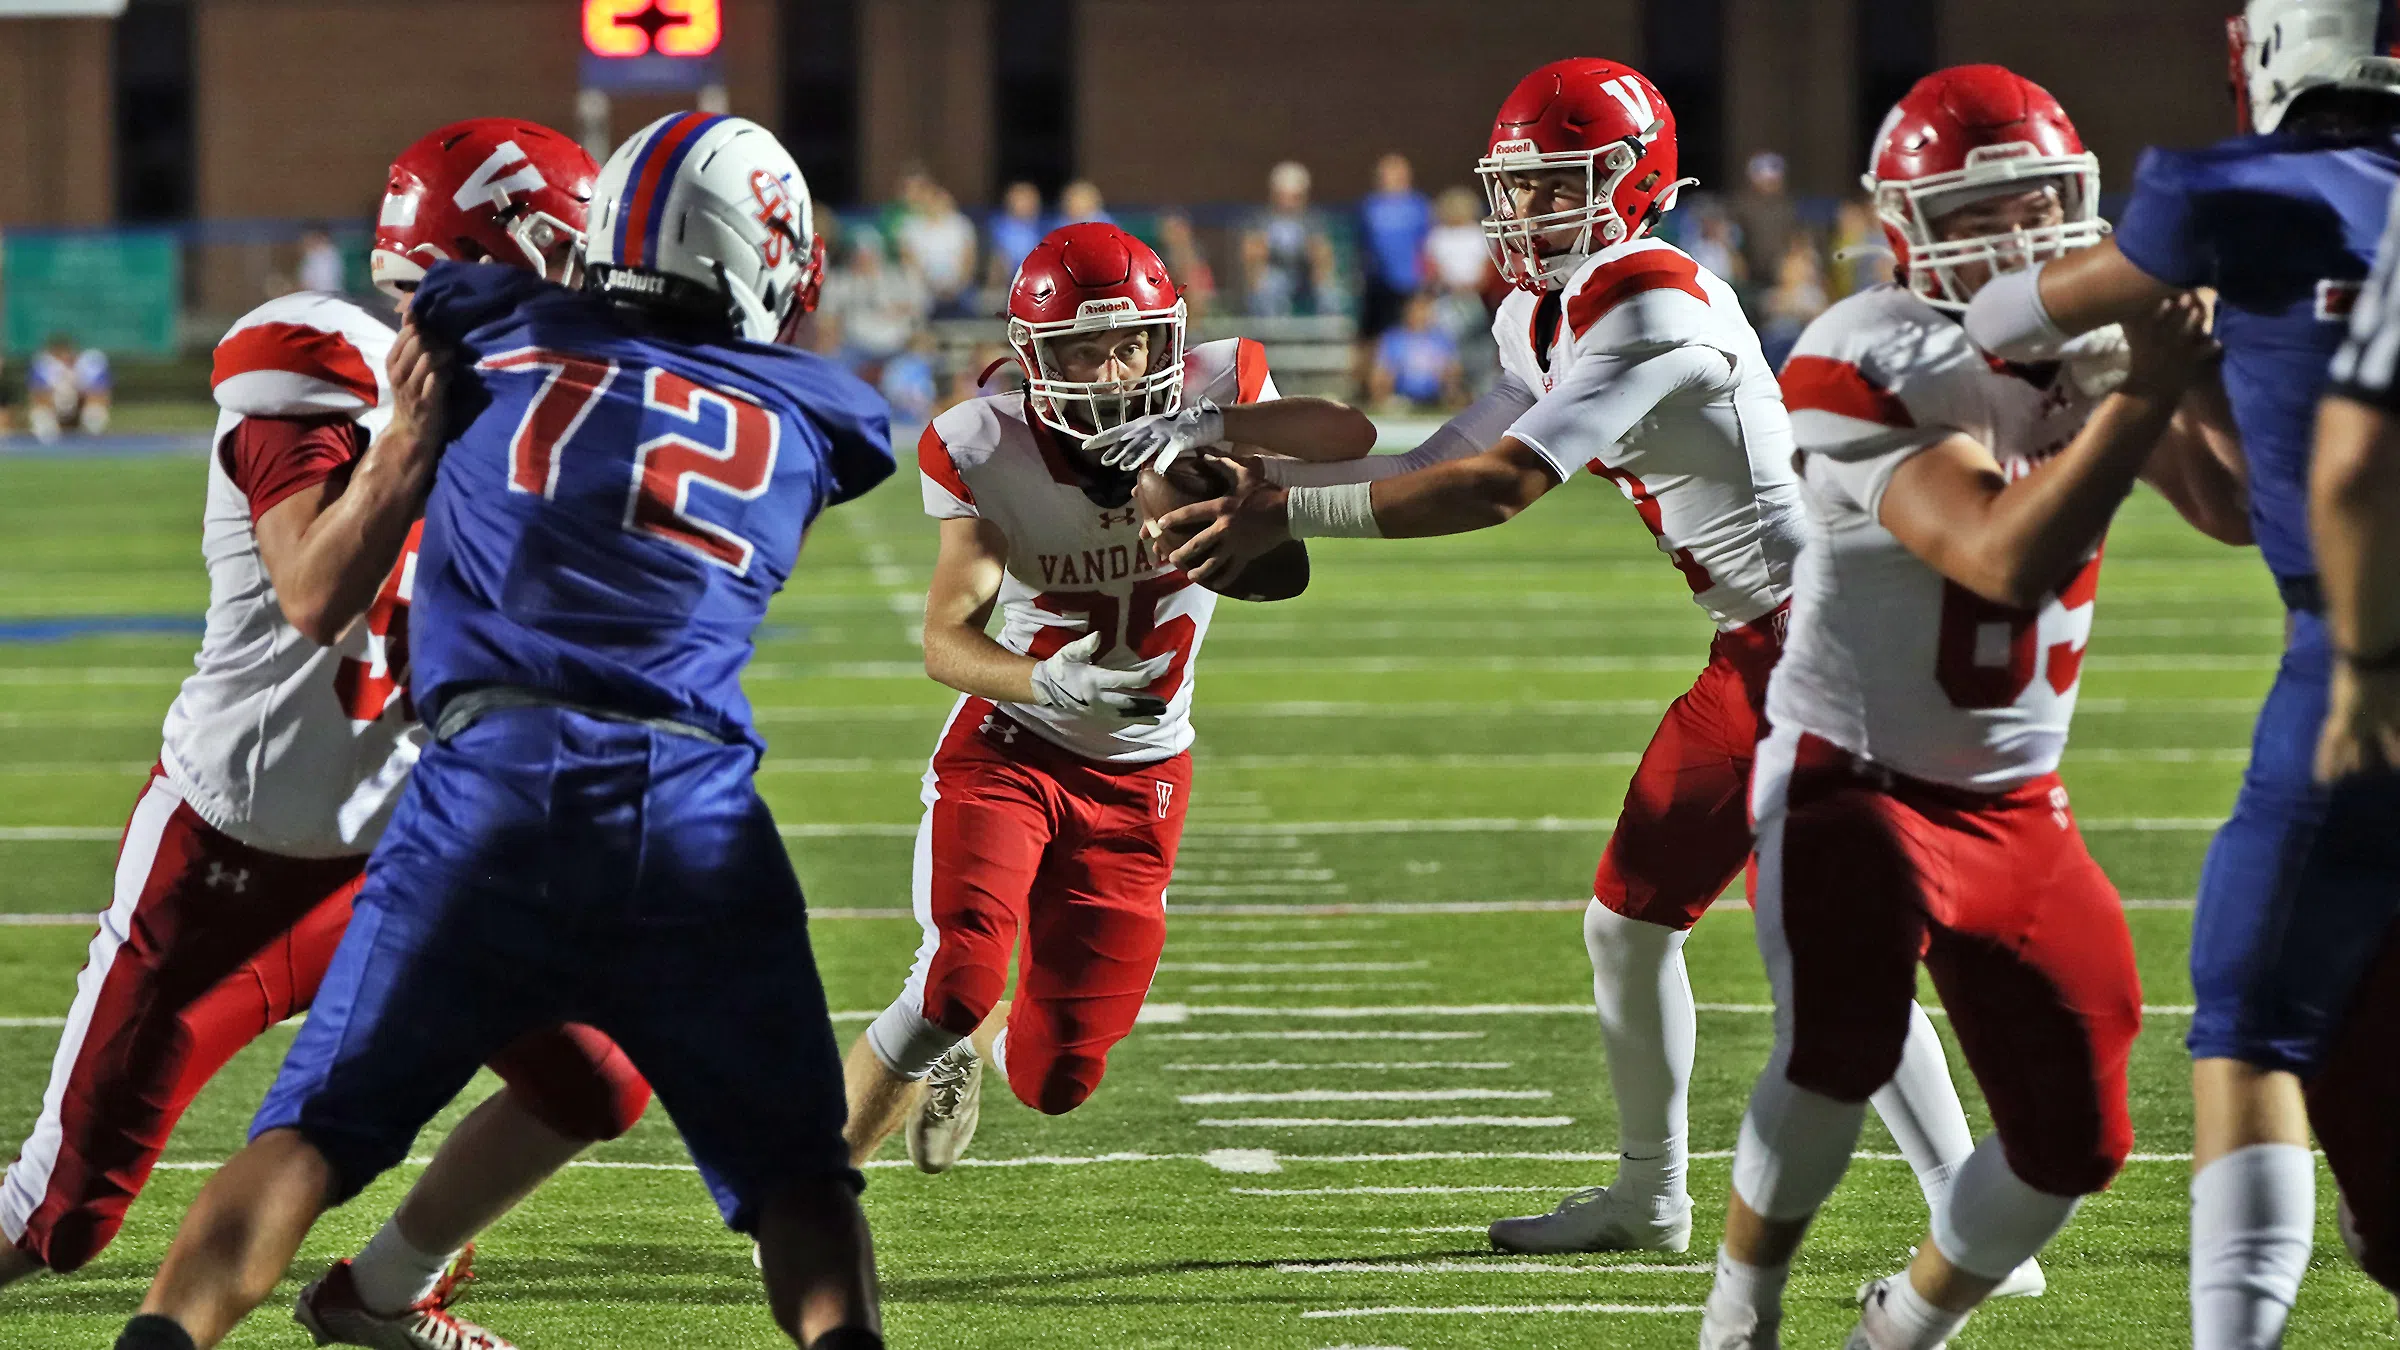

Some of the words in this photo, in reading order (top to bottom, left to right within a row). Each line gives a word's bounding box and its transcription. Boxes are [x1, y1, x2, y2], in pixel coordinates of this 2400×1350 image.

[1600, 75, 1658, 141] V
[453, 140, 547, 212] V
[1496, 142, 1531, 154] Riddell
[1085, 301, 1130, 315] Riddell
[474, 346, 780, 577] 72
[1038, 539, 1171, 585] VANDA
